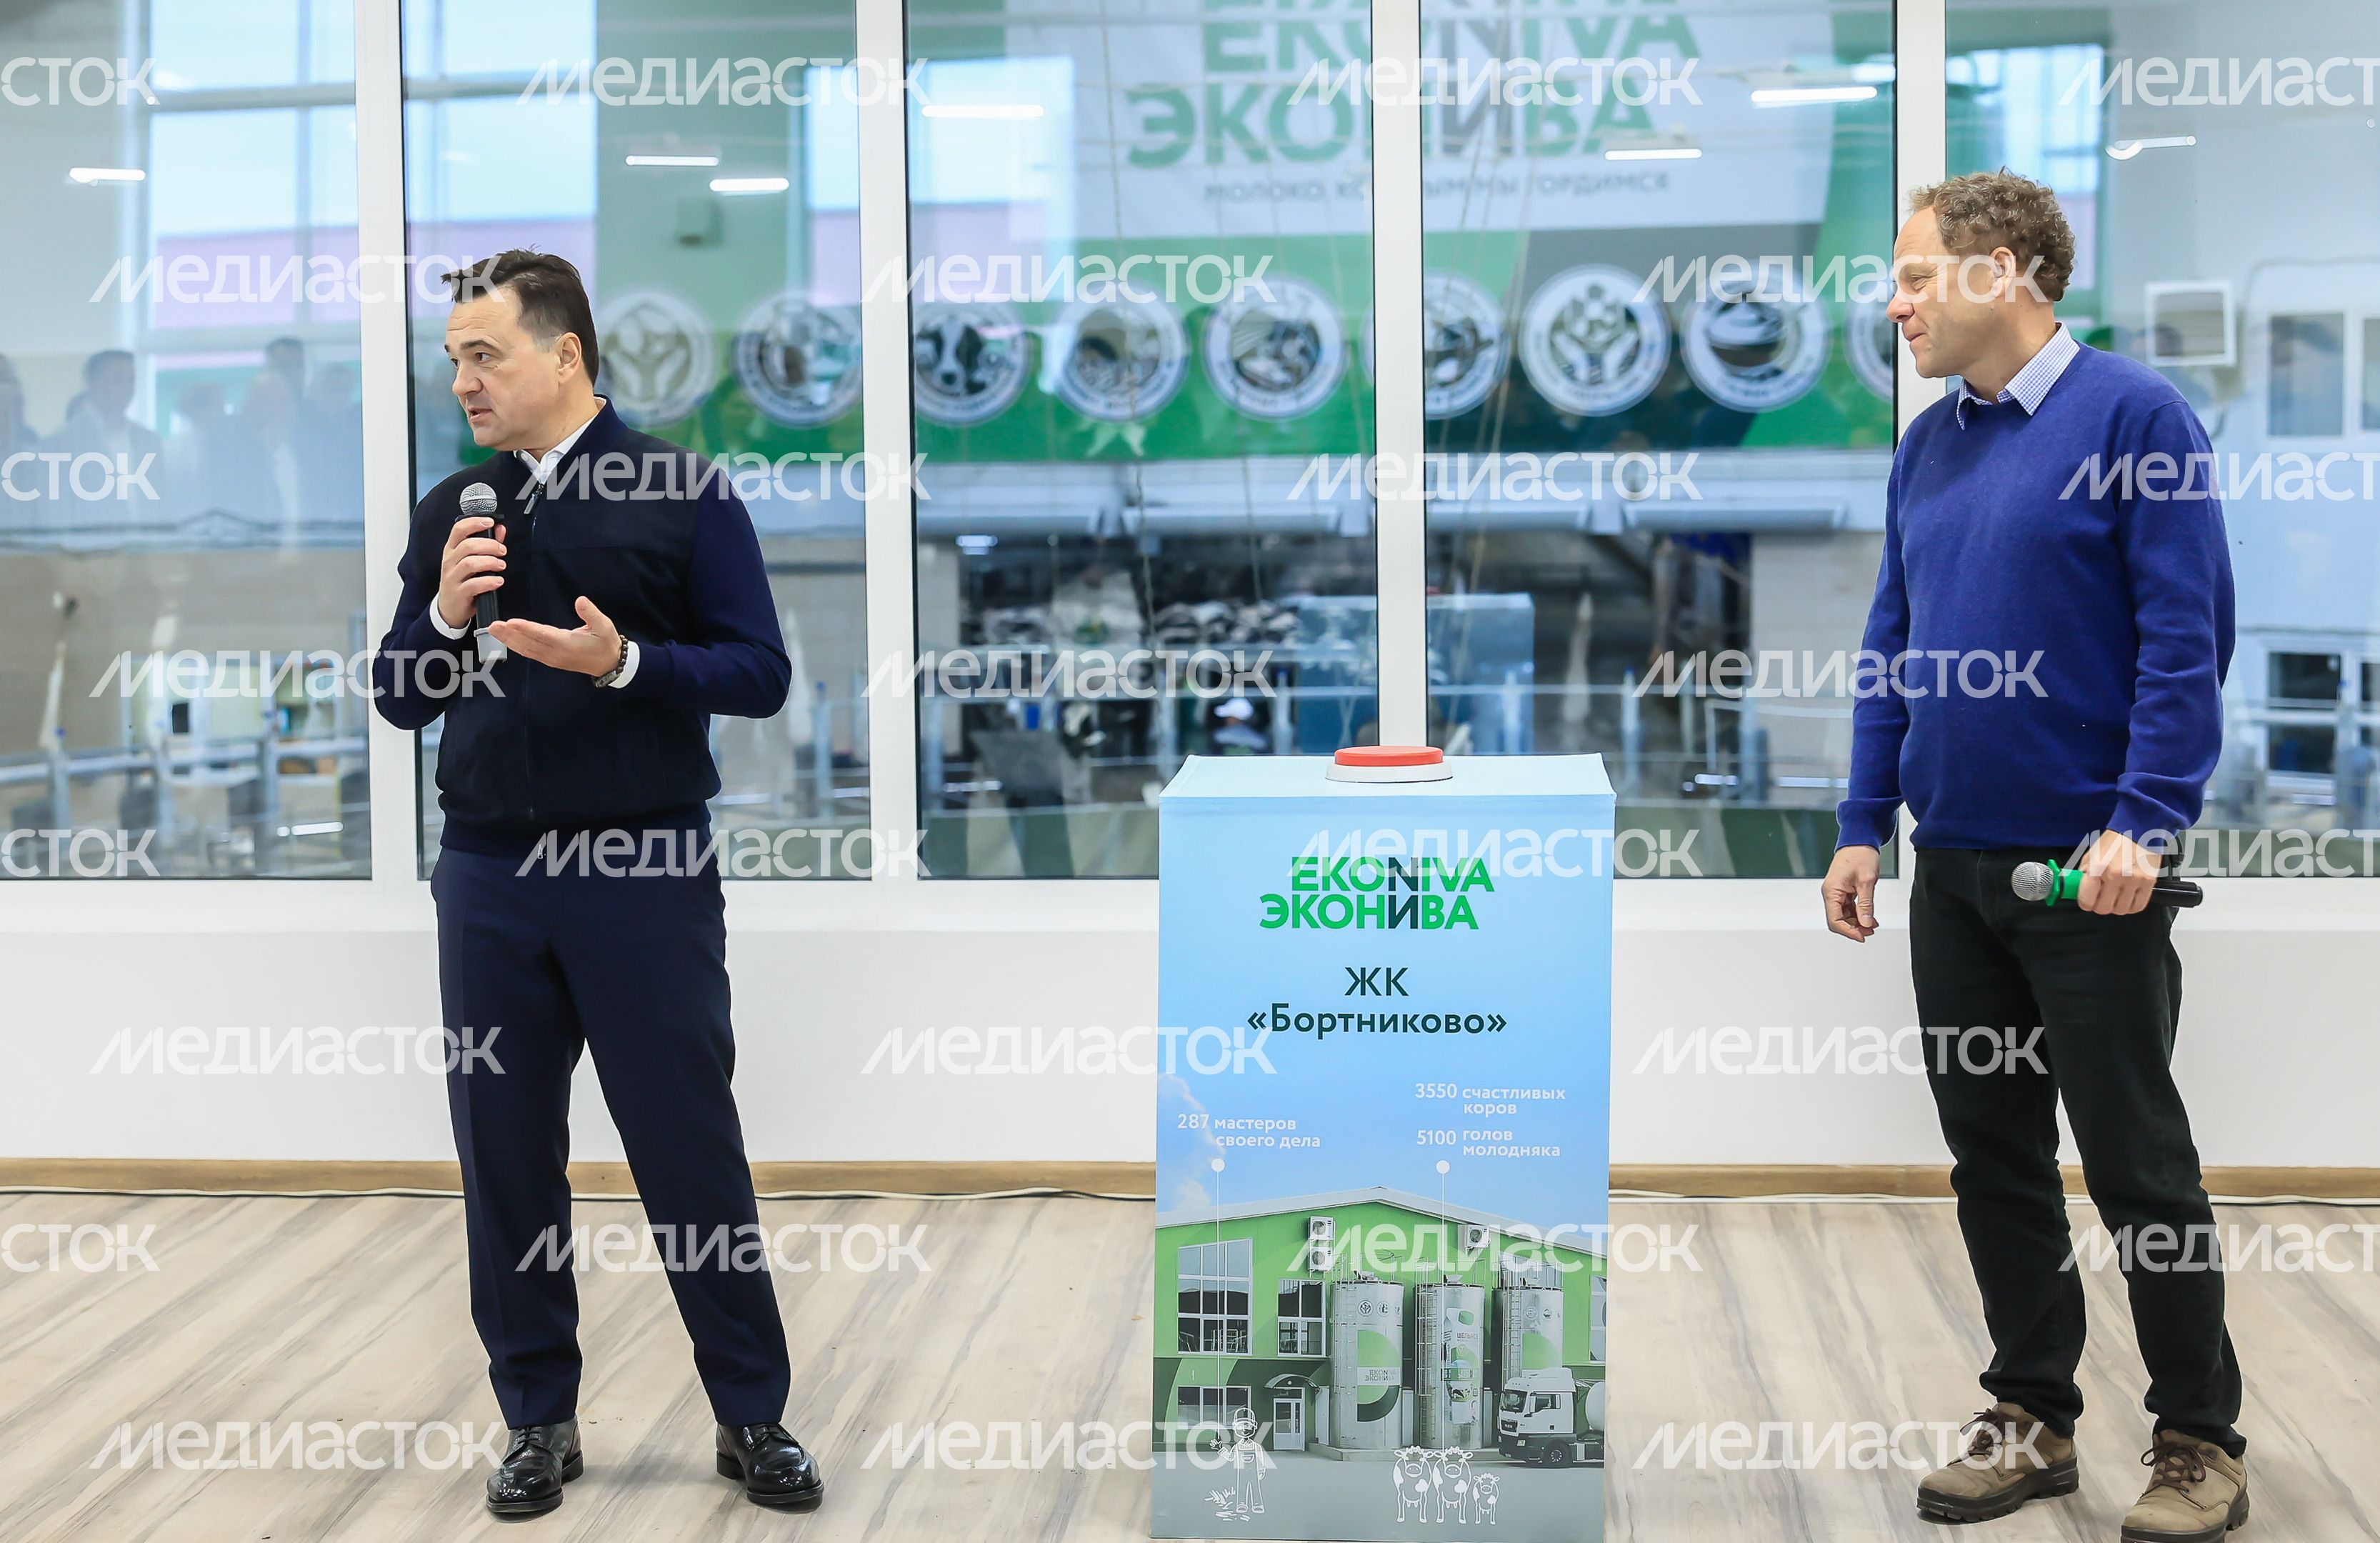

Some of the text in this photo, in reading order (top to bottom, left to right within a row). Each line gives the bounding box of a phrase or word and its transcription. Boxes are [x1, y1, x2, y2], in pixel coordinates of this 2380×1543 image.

[1127, 77, 1657, 169] ЭКОИВА
[1291, 857, 1495, 892] EKONIVA
[1259, 894, 1479, 929] ЭКОНИВА
[1344, 967, 1409, 997] ЖК
[1247, 1003, 1507, 1040] «Бортниково»
[1415, 1083, 1566, 1099] 3550 счастливых
[1464, 1104, 1517, 1118] коров
[1178, 1114, 1297, 1134] 287 мастеров
[1216, 1136, 1321, 1149] своего дела
[1416, 1129, 1514, 1145] 5100 голов
[1463, 1145, 1561, 1158] молодняка
